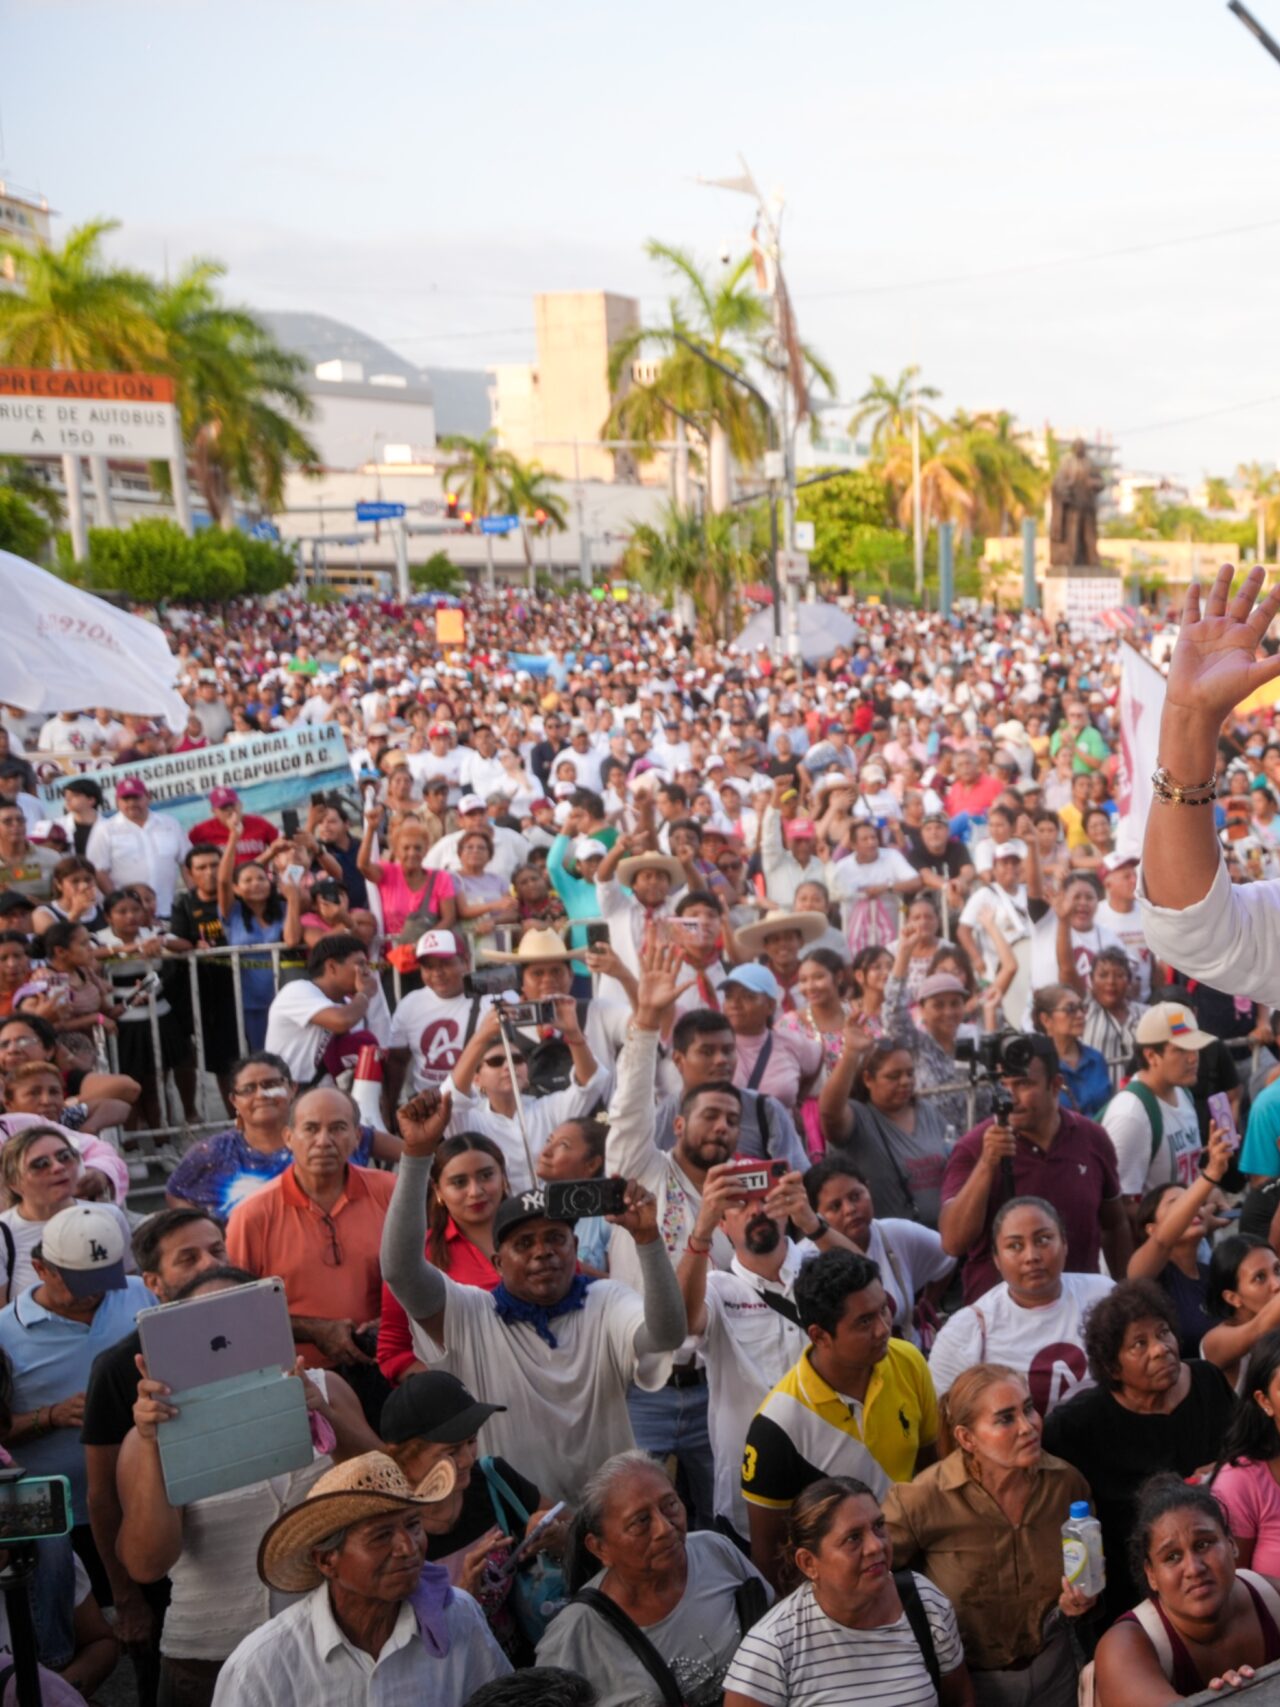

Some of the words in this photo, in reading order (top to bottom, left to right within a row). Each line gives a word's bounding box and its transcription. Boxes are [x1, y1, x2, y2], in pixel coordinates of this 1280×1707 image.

[0, 374, 155, 398] PRECAUCION
[58, 407, 78, 423] DE
[89, 409, 165, 425] AUTOBUS
[31, 427, 44, 443] A
[60, 429, 94, 445] 150
[229, 748, 247, 763] EN
[297, 731, 316, 745] DE
[319, 727, 336, 741] LA
[149, 779, 196, 800] NITOS
[200, 773, 218, 791] DE
[222, 755, 301, 785] ACAPULCO
[88, 1239, 109, 1263] LA
[741, 1443, 758, 1482] 3
